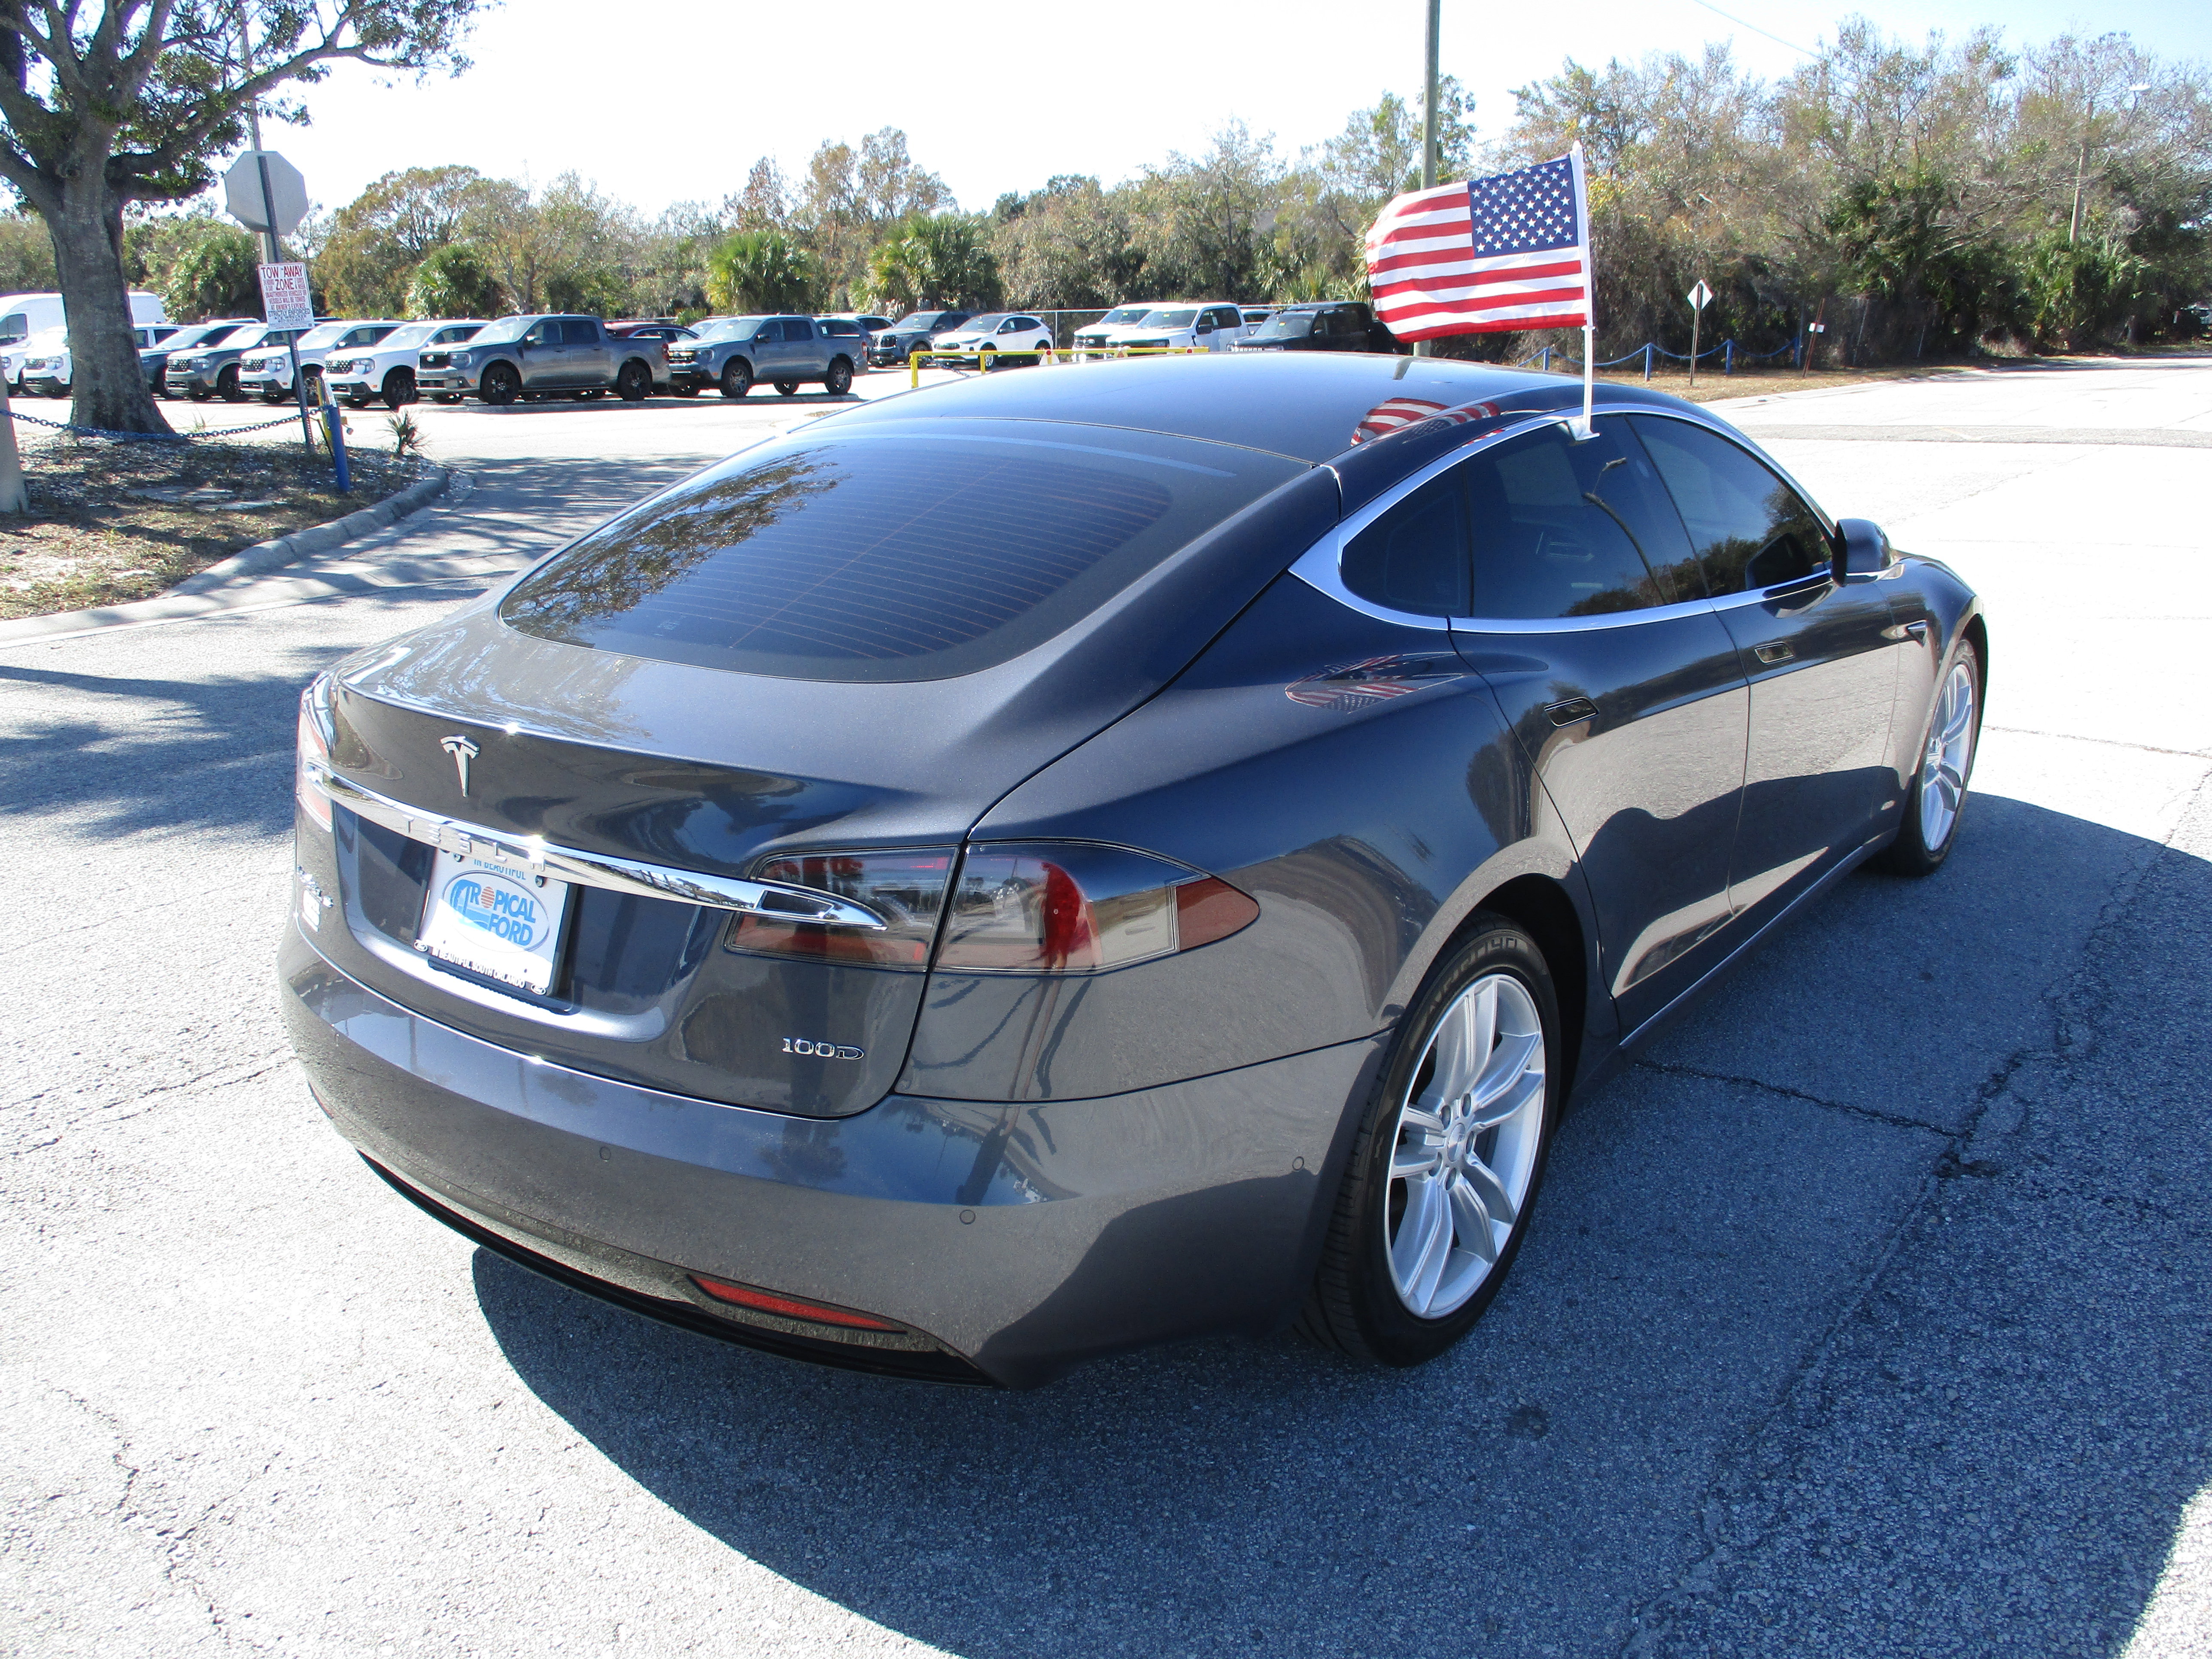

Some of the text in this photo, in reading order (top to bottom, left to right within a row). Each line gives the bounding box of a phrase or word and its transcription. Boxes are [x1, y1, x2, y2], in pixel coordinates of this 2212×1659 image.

[261, 265, 302, 279] TOW AWAY
[275, 278, 295, 290] ZONE
[487, 913, 533, 946] FORD
[440, 950, 472, 969] BEAUTIFUL
[471, 962, 494, 977] SOUTH
[493, 971, 526, 989] ORLANDO
[782, 1037, 864, 1060] 100D
